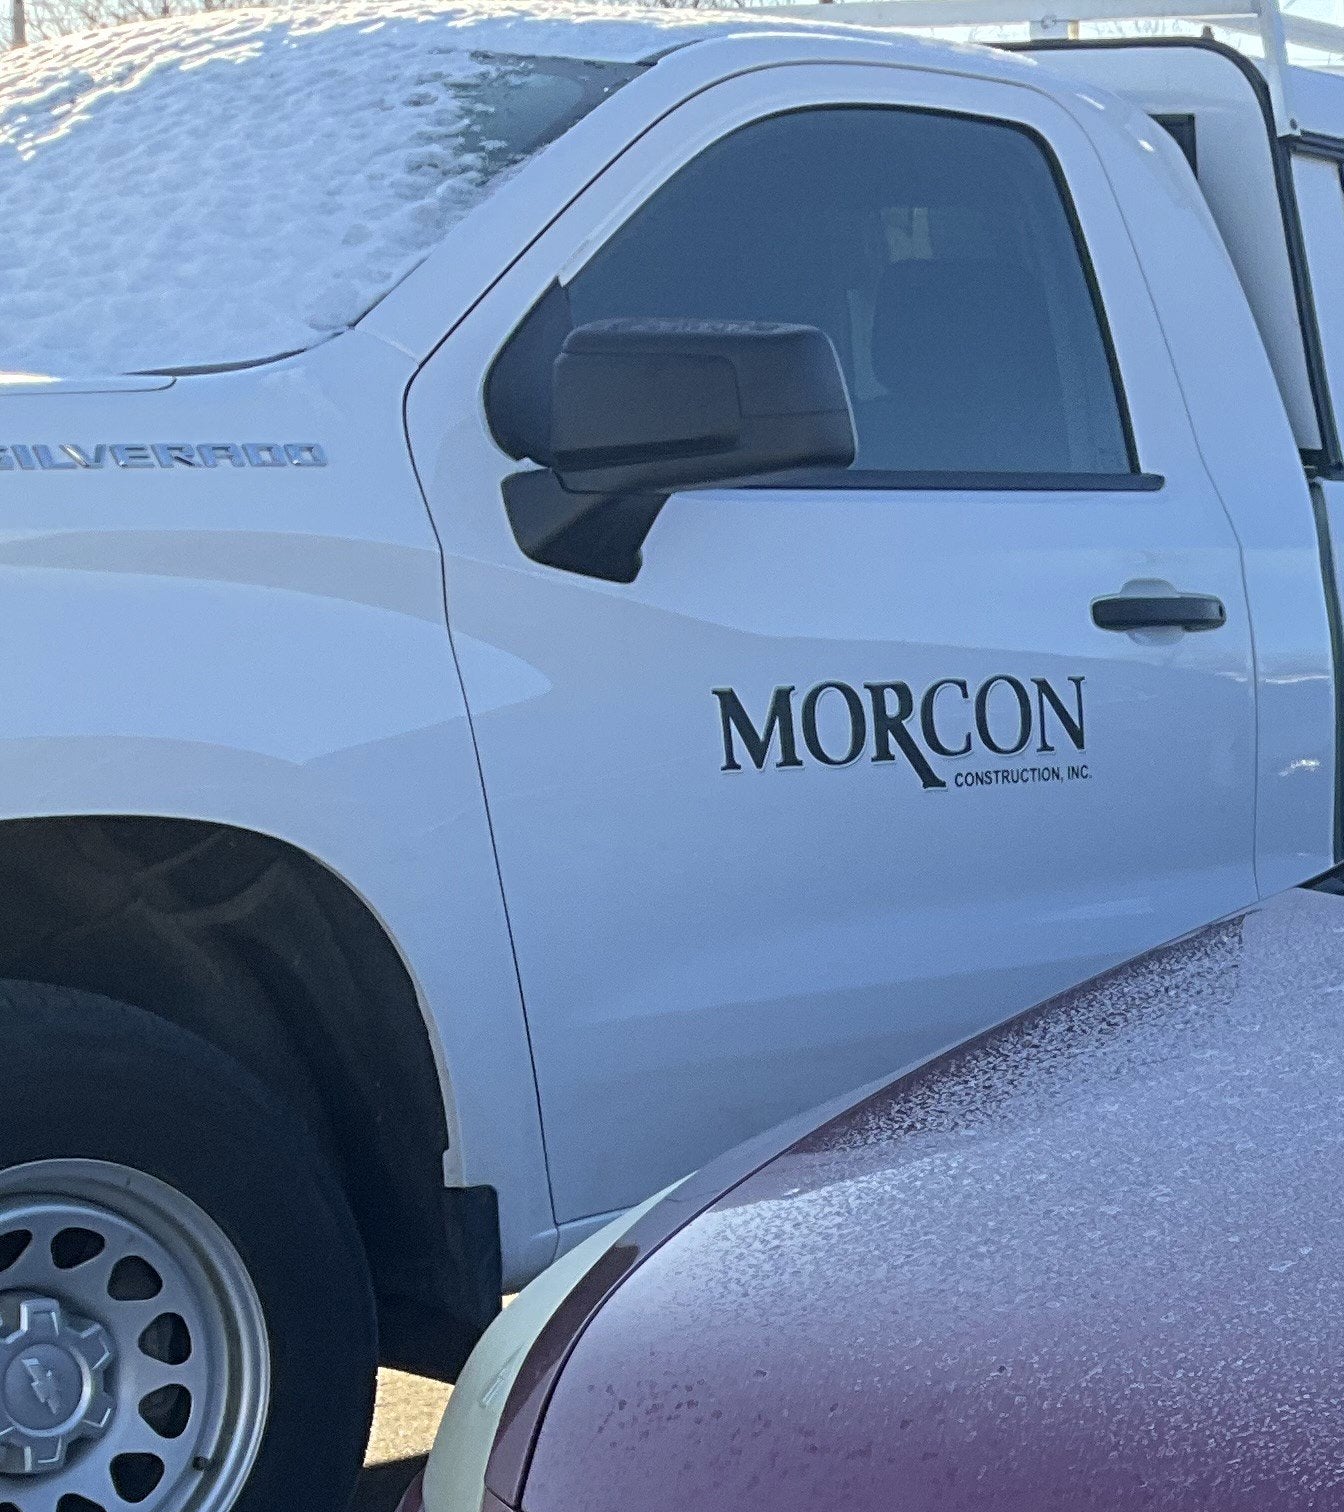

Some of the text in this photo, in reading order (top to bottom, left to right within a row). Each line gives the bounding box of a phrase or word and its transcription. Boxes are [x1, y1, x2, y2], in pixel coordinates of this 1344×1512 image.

[711, 674, 1086, 790] MORCON
[953, 764, 1093, 788] CONSTRUCTION, INC.
